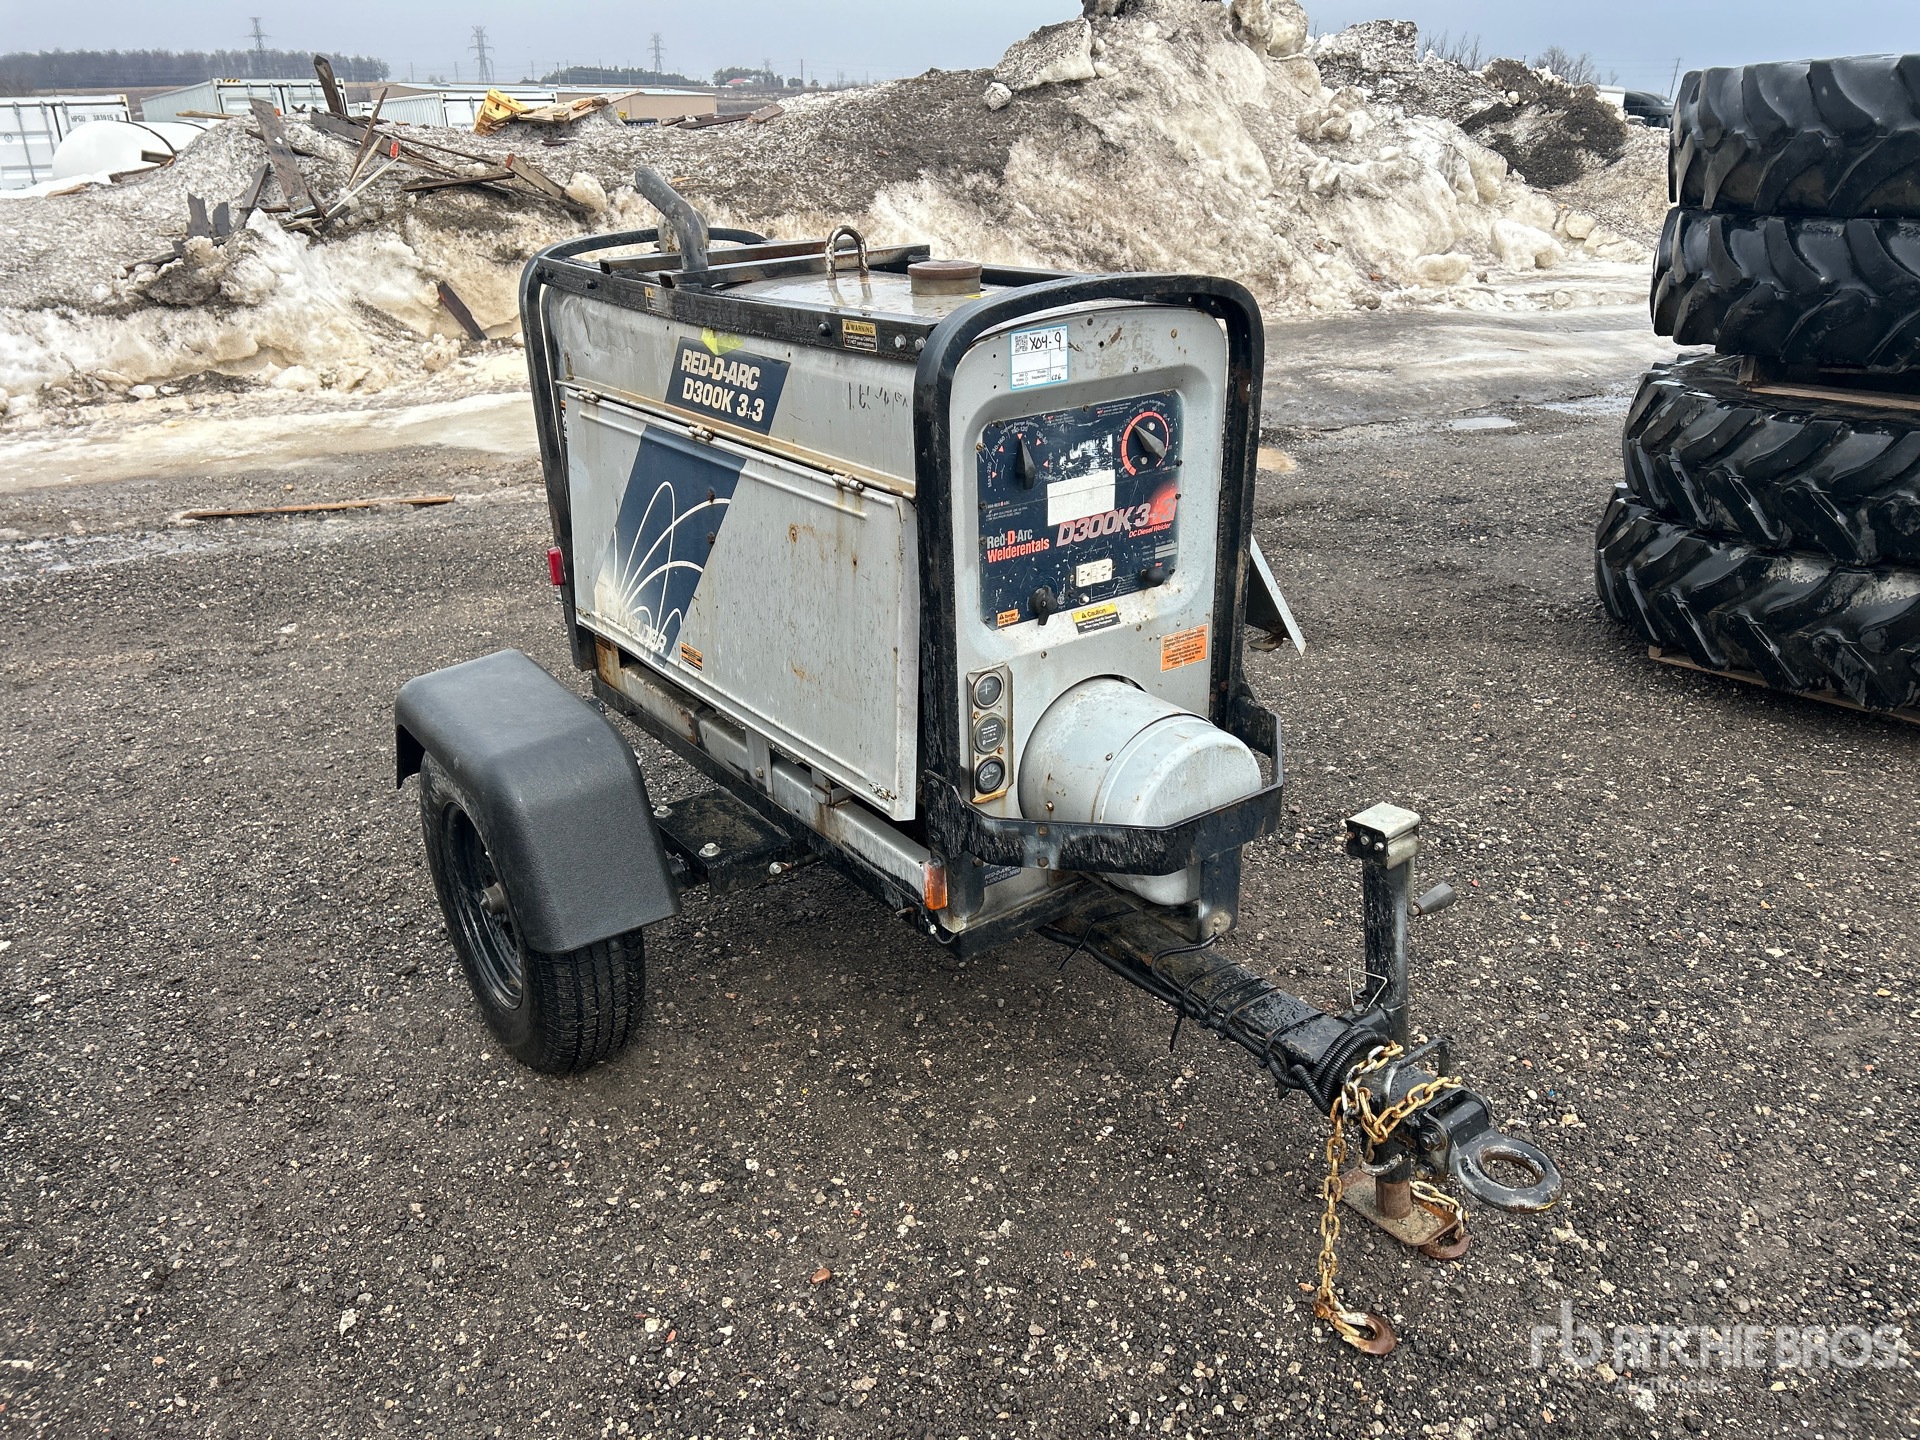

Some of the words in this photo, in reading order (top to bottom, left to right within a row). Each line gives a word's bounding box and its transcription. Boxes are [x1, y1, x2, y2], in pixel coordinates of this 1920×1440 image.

[850, 324, 873, 333] WARNING
[680, 348, 760, 390] RED-D-ARC
[682, 377, 735, 413] D300K
[737, 394, 765, 422] 3+3
[1056, 506, 1135, 547] D300K
[1129, 530, 1138, 538] DC
[1138, 526, 1154, 536] Diesel
[1154, 522, 1172, 532] Welder
[987, 529, 1032, 549] Red-D-Arc
[987, 538, 1050, 563] Welderentals
[1087, 609, 1106, 617] Caution
